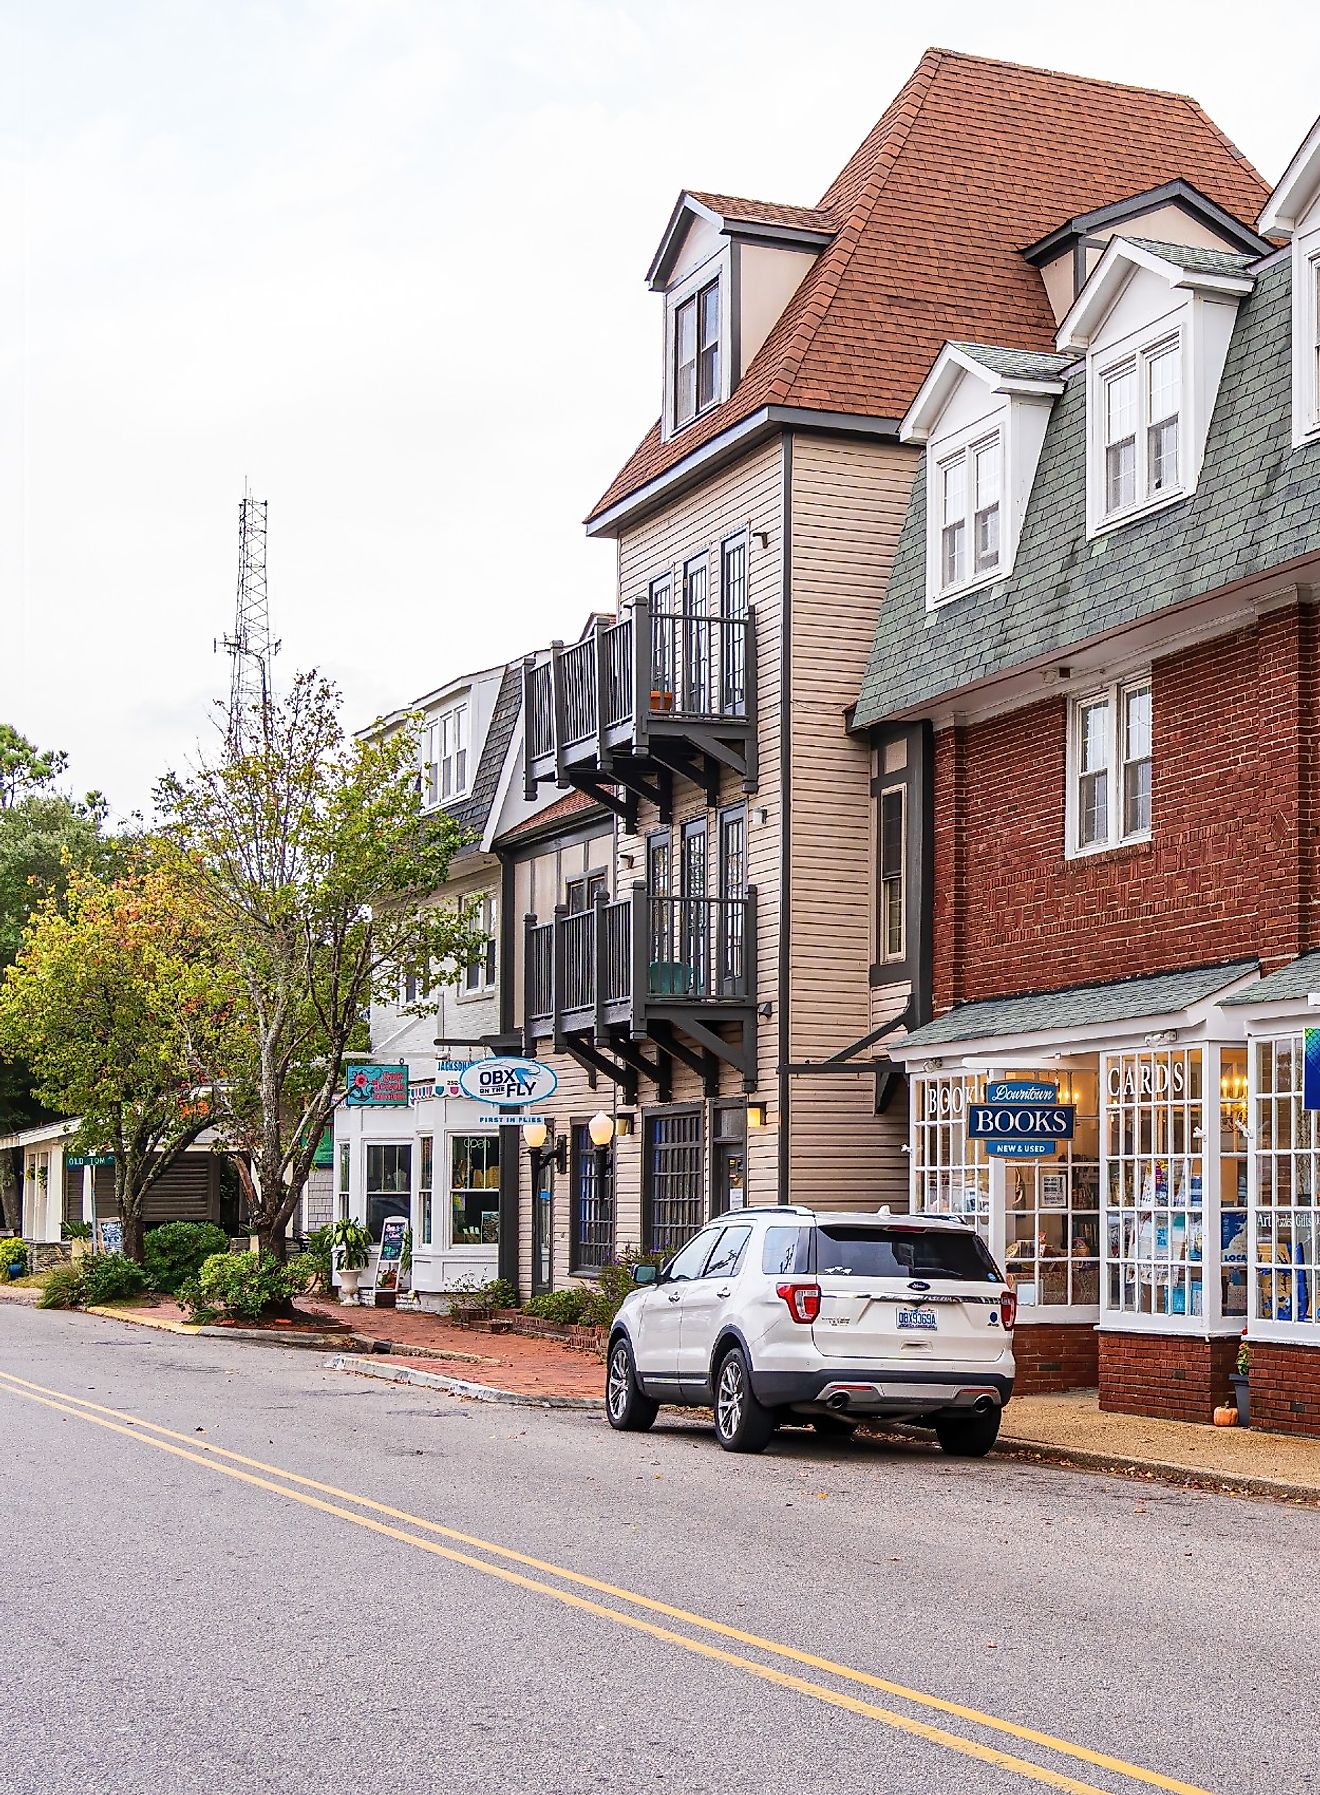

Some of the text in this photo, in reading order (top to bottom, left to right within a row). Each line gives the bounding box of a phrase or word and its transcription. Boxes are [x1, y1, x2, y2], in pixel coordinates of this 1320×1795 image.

[479, 1069, 516, 1085] OBX
[1107, 1062, 1184, 1097] CARDS
[506, 1081, 537, 1098] FLY
[991, 1084, 1054, 1102] Downtown
[479, 1116, 542, 1124] FIRST IN FLIES
[975, 1109, 1068, 1133] BOOKS
[996, 1144, 1046, 1154] NEW & USED
[68, 1157, 84, 1166] OLD
[1256, 1213, 1272, 1227] Art
